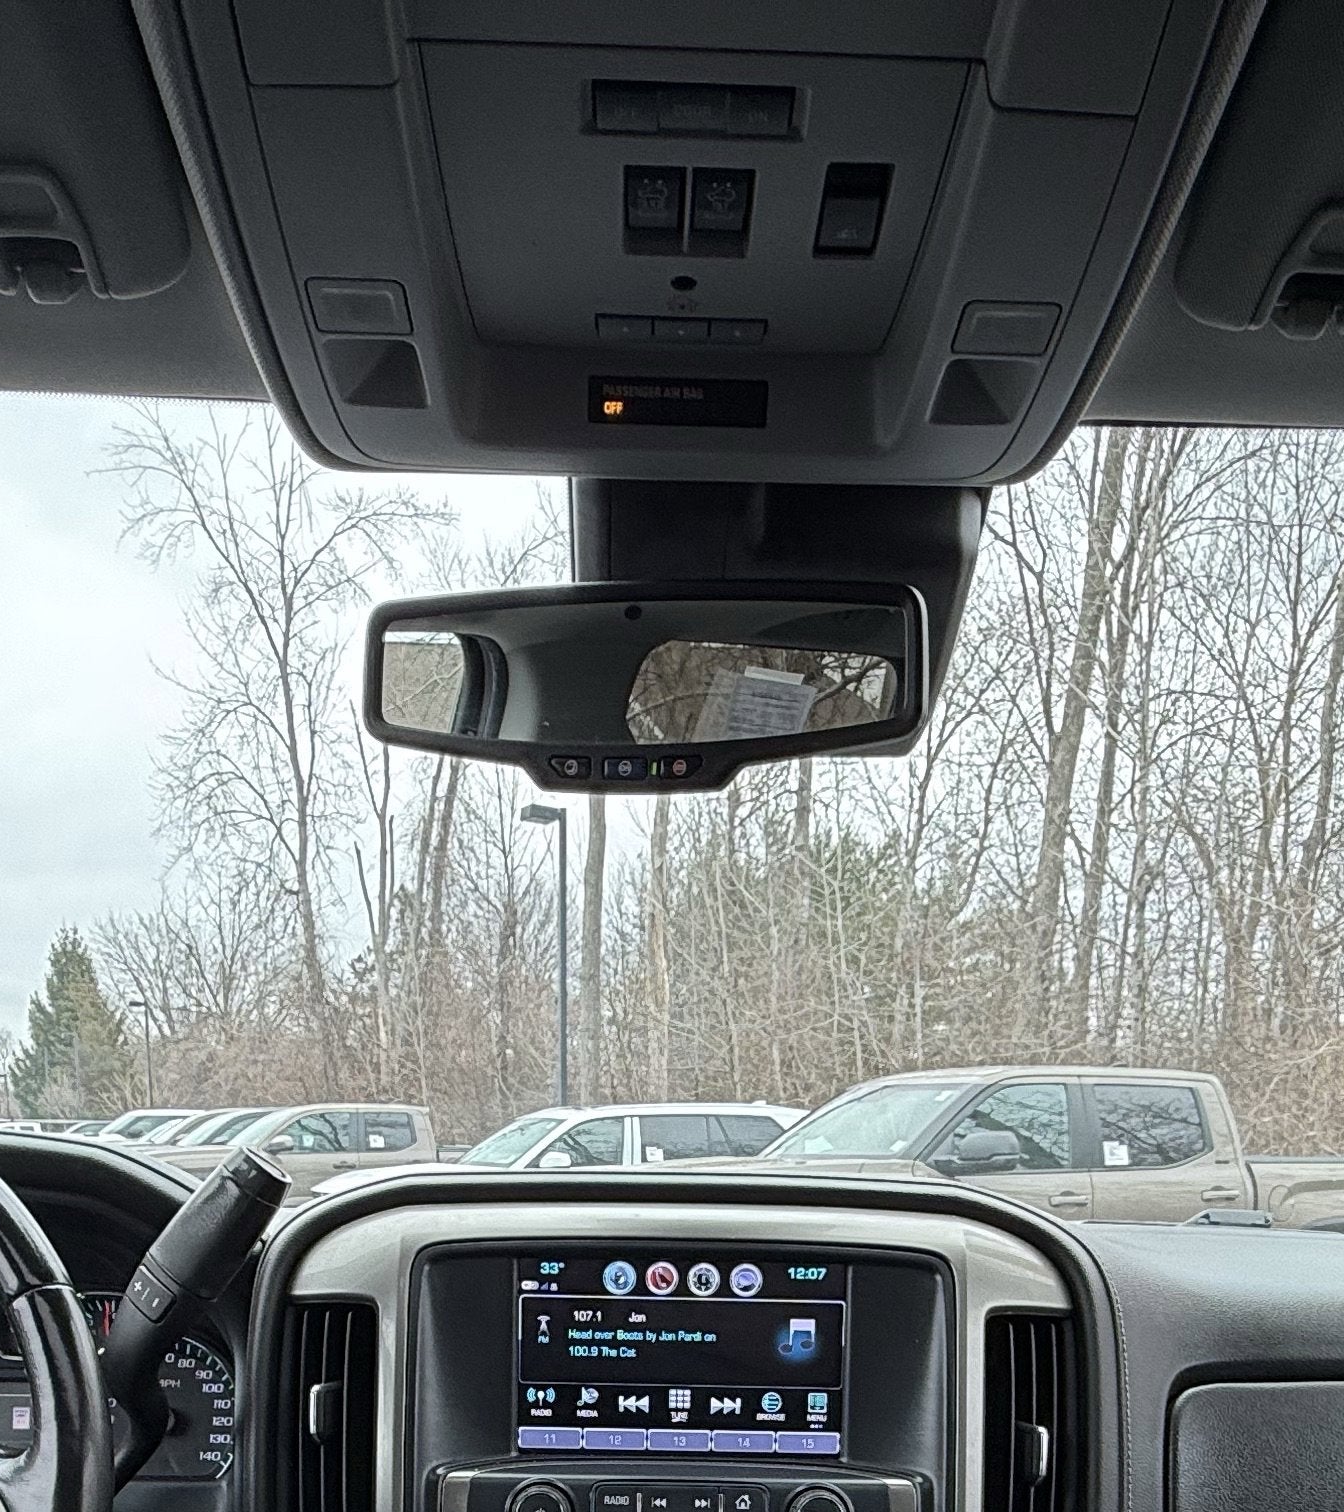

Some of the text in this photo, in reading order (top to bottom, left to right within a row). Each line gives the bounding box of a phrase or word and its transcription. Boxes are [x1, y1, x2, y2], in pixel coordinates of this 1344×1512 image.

[602, 384, 662, 398] PASSENGER
[663, 386, 681, 399] AIR
[603, 401, 624, 416] OFF
[540, 1262, 565, 1274] 33°
[787, 1267, 827, 1280] 12:07
[573, 1310, 602, 1322] 107.1
[568, 1329, 593, 1340] Head
[594, 1331, 615, 1340] over
[616, 1329, 644, 1341] Boots
[645, 1330, 657, 1343] by
[703, 1333, 717, 1341] on
[600, 1346, 617, 1357] The
[177, 1358, 196, 1369] 80
[195, 1370, 213, 1380] 90
[201, 1383, 225, 1393] 100
[213, 1399, 231, 1409] 110
[576, 1410, 598, 1418] MEDIA
[806, 1414, 827, 1422] MENU
[212, 1416, 233, 1427] 120
[209, 1433, 231, 1444] 130
[544, 1433, 557, 1444] 11
[608, 1434, 622, 1445] 12
[673, 1436, 687, 1446] 13
[737, 1437, 751, 1447] 14
[801, 1438, 815, 1448] 15
[199, 1451, 221, 1461] 140
[603, 1496, 630, 1506] RADIO
